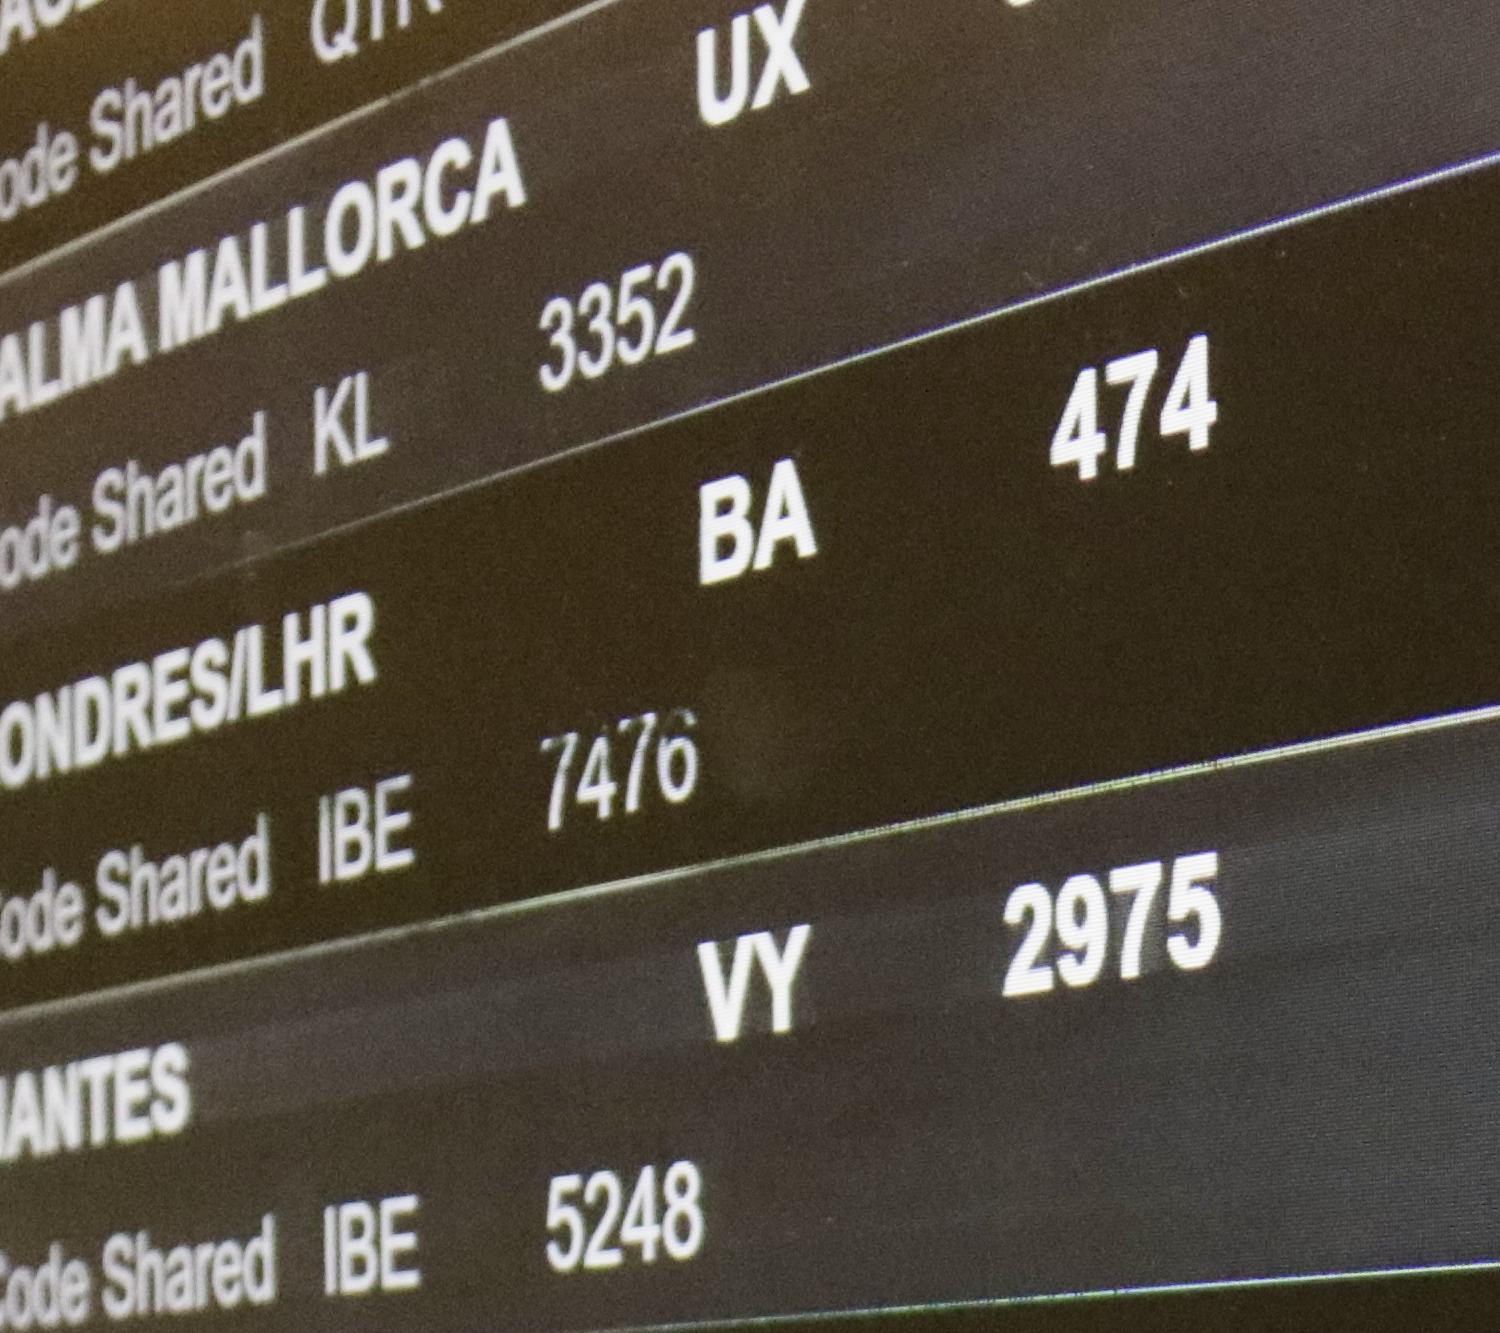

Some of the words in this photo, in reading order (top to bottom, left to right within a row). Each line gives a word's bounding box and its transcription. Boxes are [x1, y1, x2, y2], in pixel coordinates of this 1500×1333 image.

[90, 18, 263, 172] Shared
[156, 117, 527, 353] MALLORCA
[697, 0, 809, 126] UX
[93, 412, 266, 552] Shared
[315, 372, 388, 474] KL
[540, 252, 694, 391] 3352
[700, 459, 817, 585] BA
[1051, 334, 1217, 481] 474
[96, 817, 269, 936] Shared
[319, 776, 413, 883] IBE
[542, 712, 697, 830] 7476
[698, 924, 810, 1042] VY
[1003, 851, 1222, 997] 2975
[103, 1215, 276, 1319] Shared
[325, 1195, 420, 1294] IBE
[547, 1160, 703, 1271] 5248
